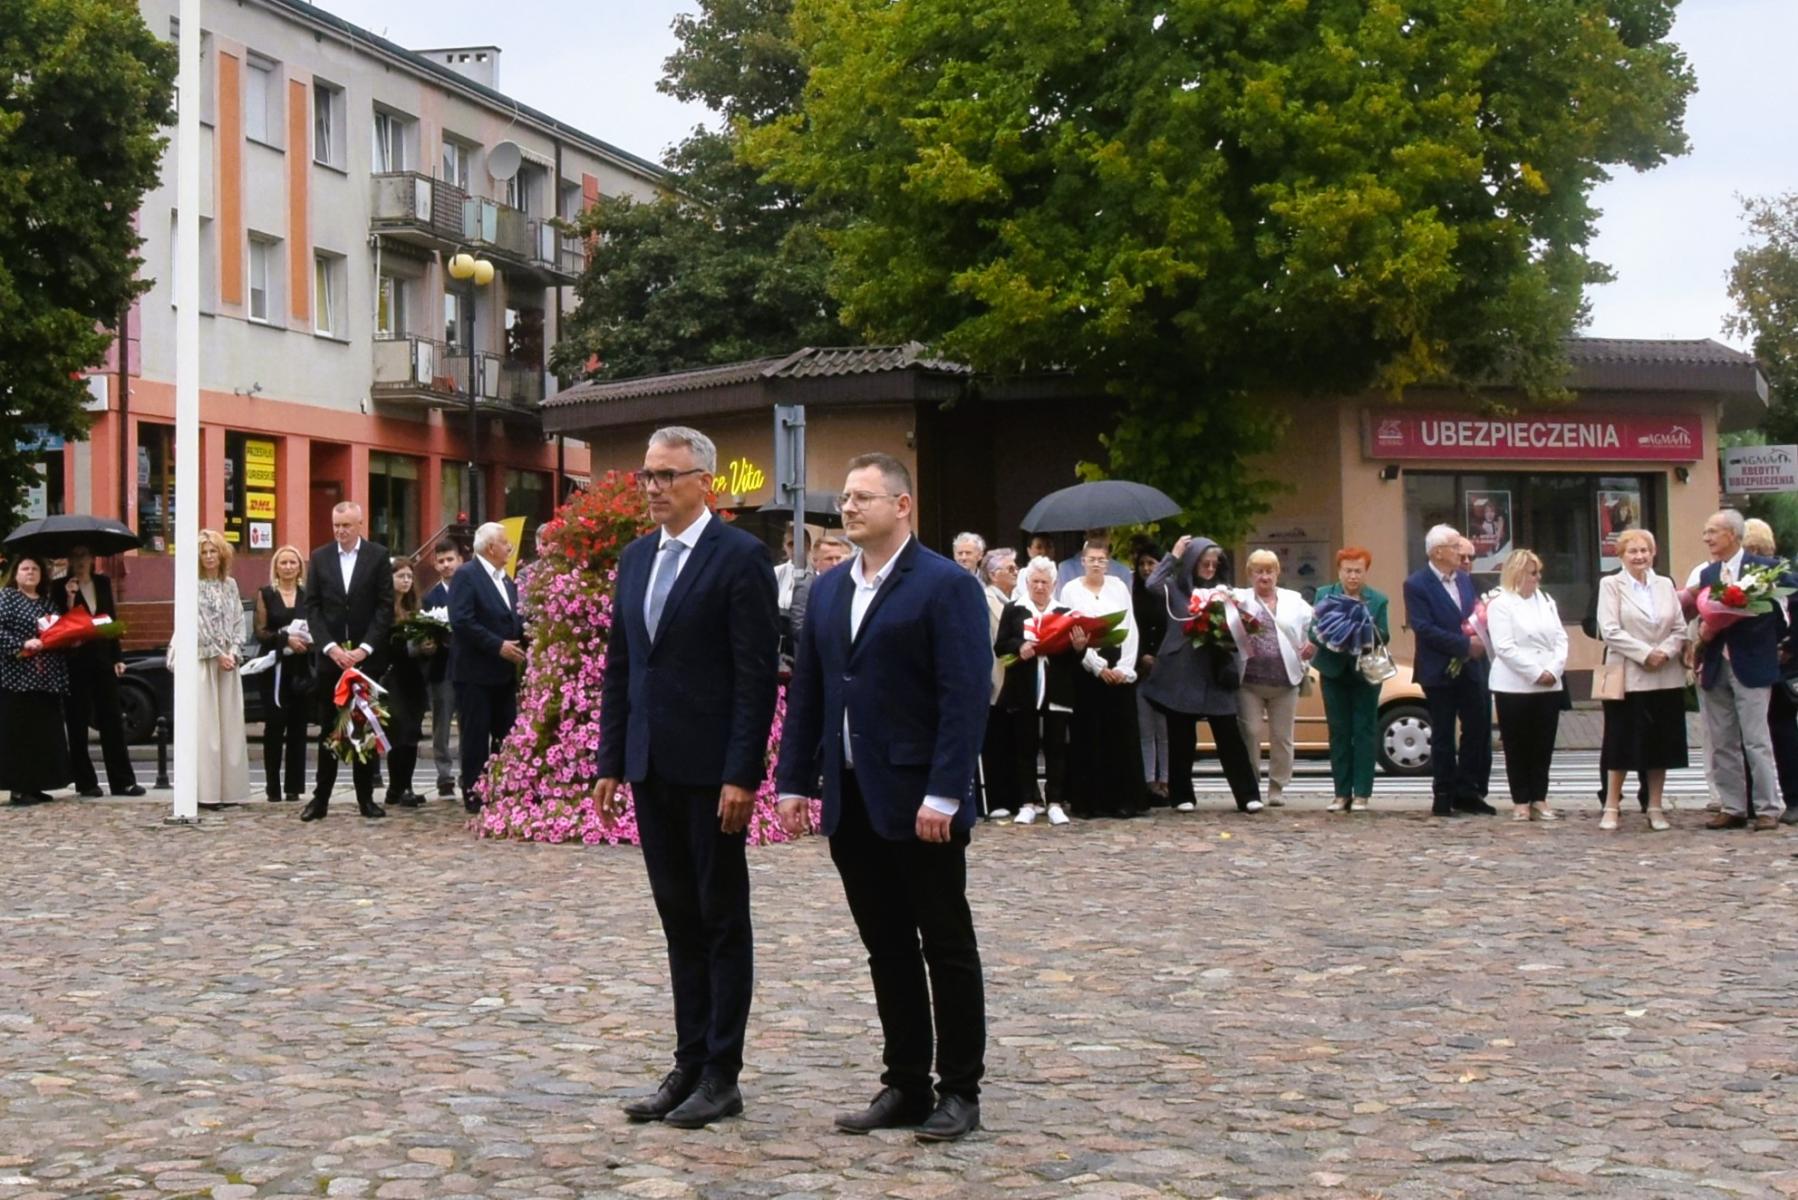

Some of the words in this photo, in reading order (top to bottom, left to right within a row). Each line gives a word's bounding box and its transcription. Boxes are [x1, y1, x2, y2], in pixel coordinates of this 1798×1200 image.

[1421, 421, 1619, 448] UBEZPIECZENIA
[729, 456, 764, 496] Vita
[1741, 465, 1781, 476] KREDYTY
[1728, 475, 1795, 488] UBEZPIECZENIA
